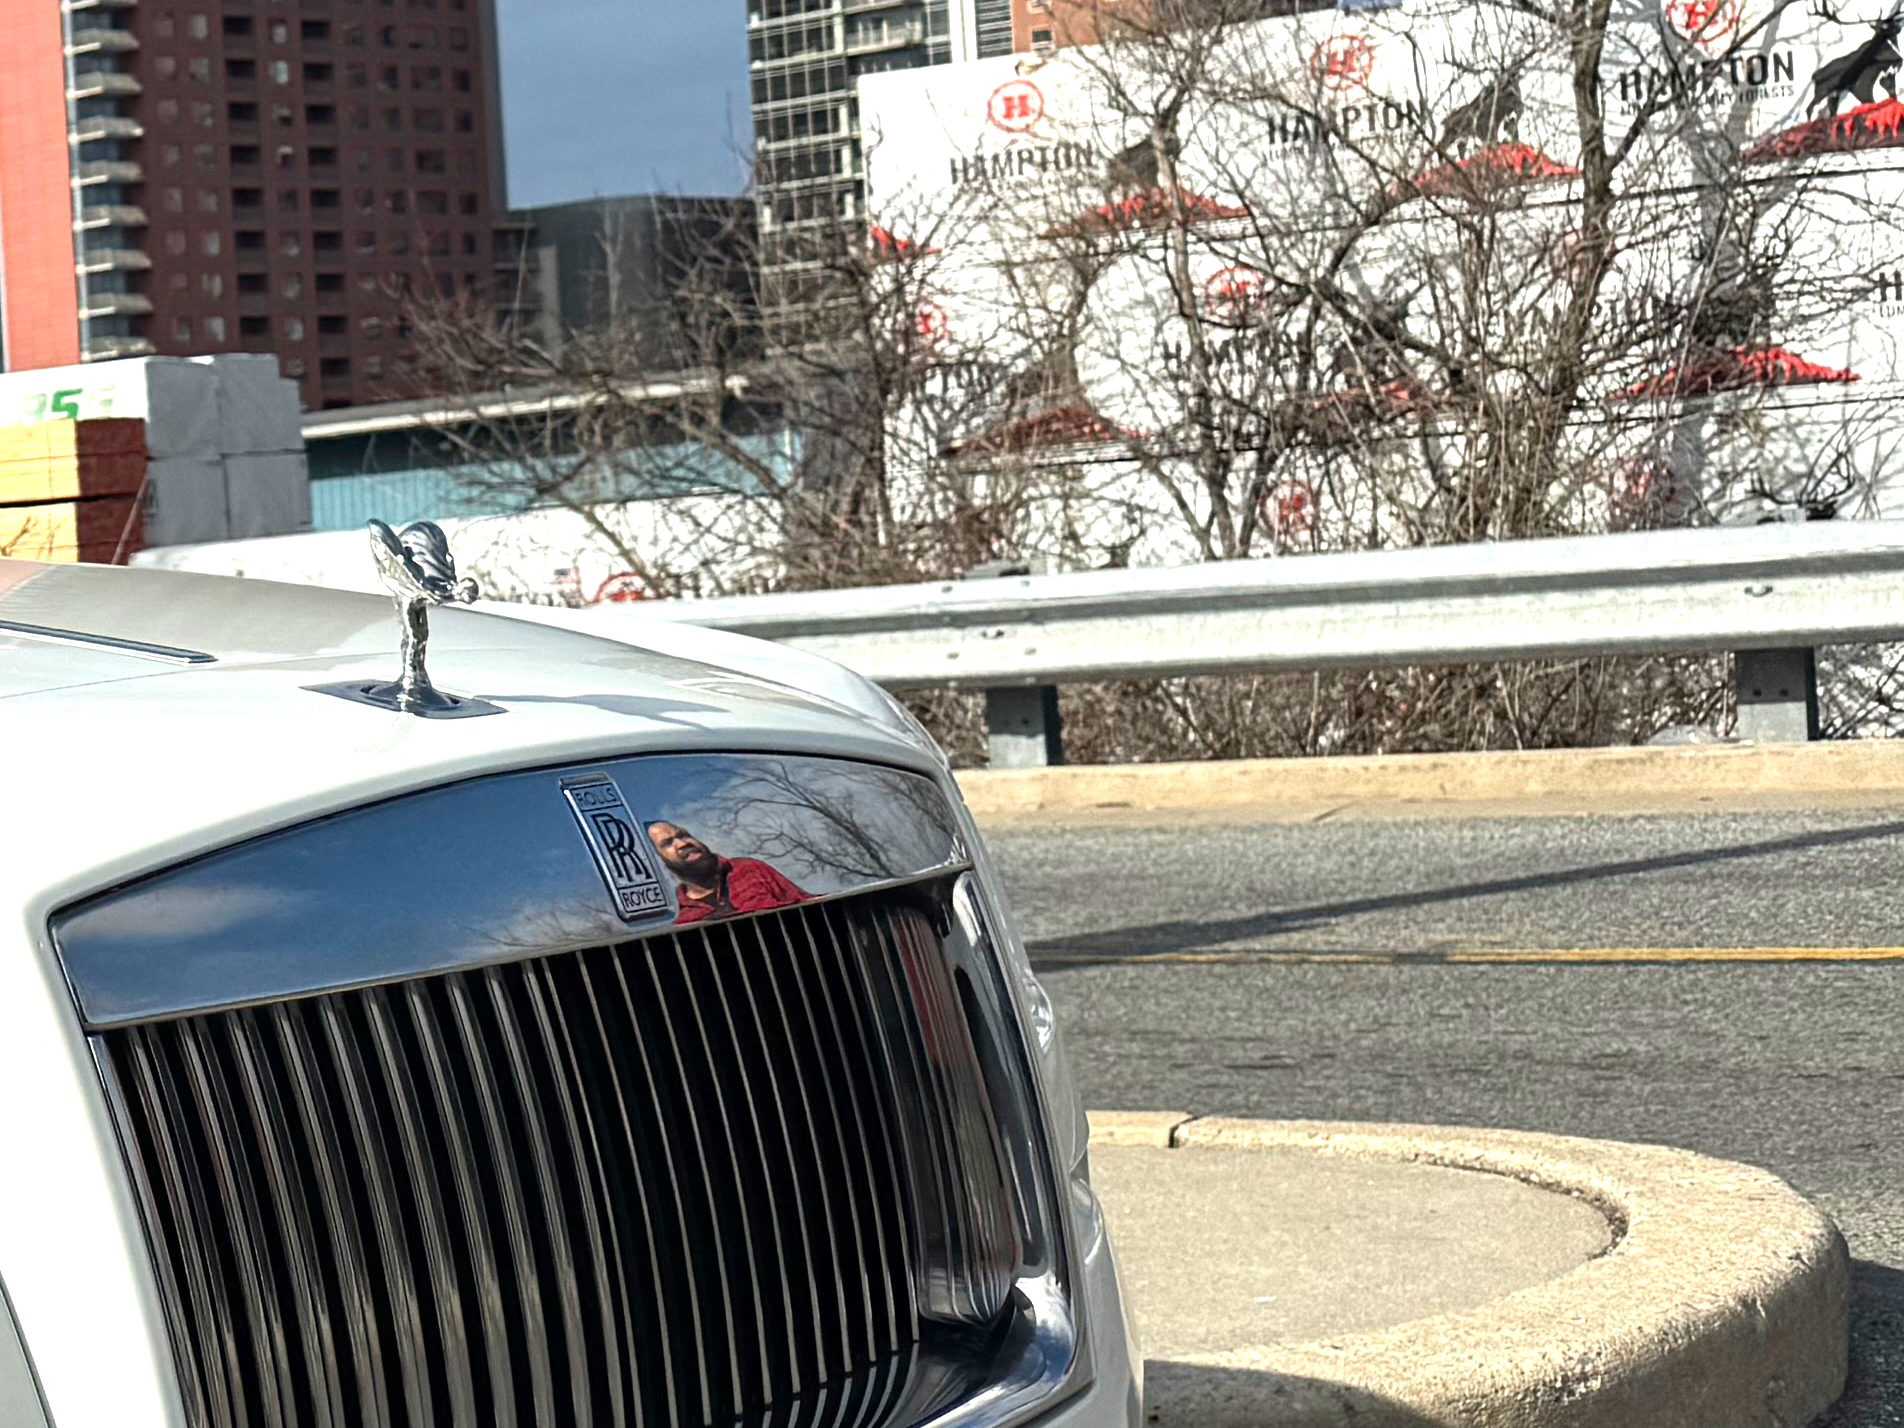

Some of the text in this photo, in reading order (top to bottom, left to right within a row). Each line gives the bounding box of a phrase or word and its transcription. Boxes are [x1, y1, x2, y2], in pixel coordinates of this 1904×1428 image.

[950, 138, 1094, 185] HAMPTON
[575, 787, 618, 806] ROLLS
[621, 886, 663, 907] ROYCE
